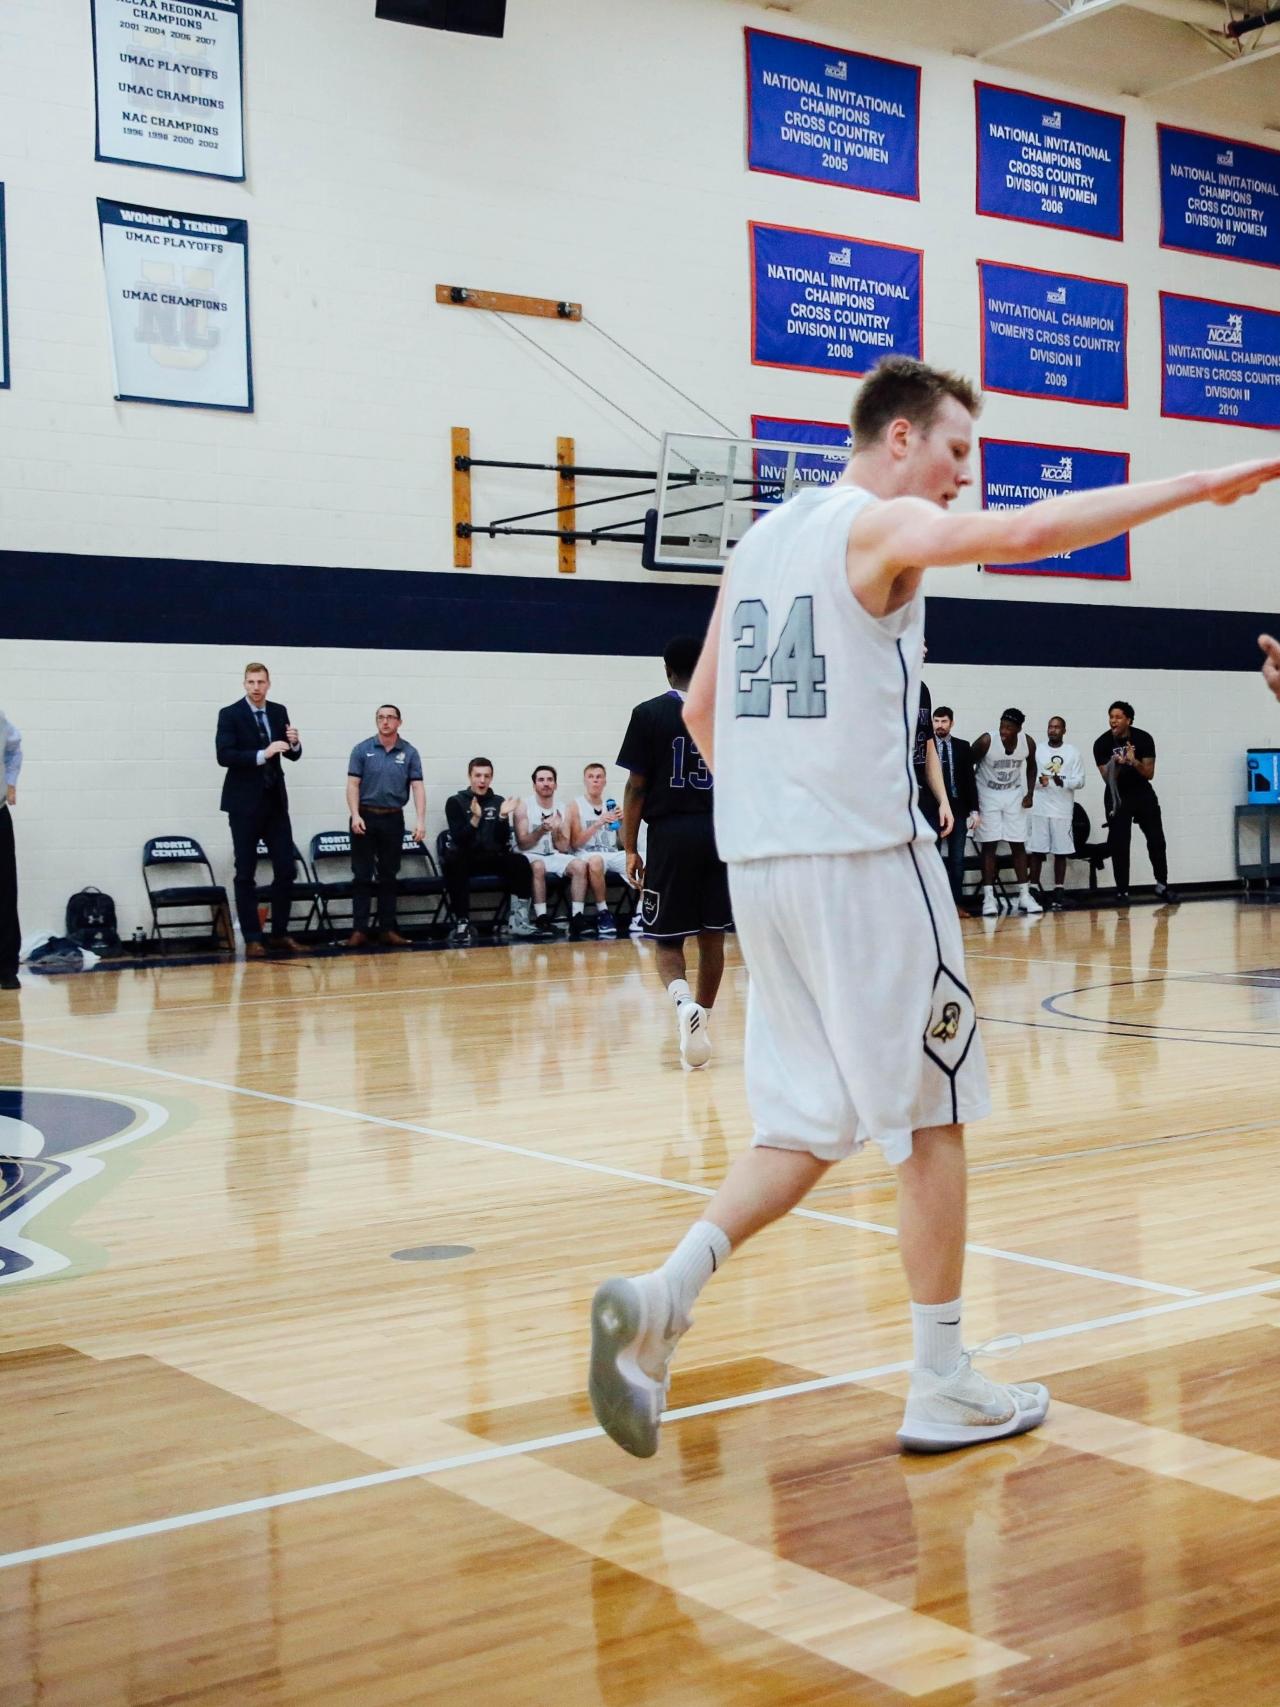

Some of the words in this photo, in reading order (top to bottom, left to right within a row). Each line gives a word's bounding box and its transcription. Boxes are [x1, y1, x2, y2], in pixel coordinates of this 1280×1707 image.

[133, 8, 203, 30] CHAMPIONS
[161, 2, 219, 21] REGIONAL
[144, 26, 166, 36] 2004
[119, 53, 154, 68] UMAC
[158, 60, 219, 80] PLAYOFFS
[118, 82, 154, 97] UMAC
[156, 89, 225, 110] CHAMPIONS
[763, 70, 823, 98] NATIONAL
[826, 86, 906, 118] INVITATIONAL
[800, 96, 870, 126] CHAMPIONS
[122, 111, 148, 125] NAC
[150, 116, 219, 136] CHAMPIONS
[784, 110, 825, 132] CROSS
[828, 121, 885, 146] COUNTRY
[781, 127, 831, 150] DIVISION
[834, 139, 841, 153] II
[844, 141, 889, 164] WOMEN
[989, 123, 1042, 147] NATIONAL
[1044, 135, 1111, 162] INVITATIONAL
[822, 153, 848, 172] 2005
[1021, 146, 1082, 170] CHAMPIONS
[1008, 160, 1044, 179] CROSS
[1046, 167, 1095, 189] COUNTRY
[1170, 163, 1217, 184] NATIONAL
[1218, 174, 1280, 196] INVITATIONAL
[1006, 175, 1049, 196] DIVISION
[1051, 186, 1057, 197] II
[1058, 187, 1098, 206] WOMEN
[1199, 185, 1252, 205] CHAMPIONS
[1041, 199, 1063, 214] 2006
[1187, 197, 1219, 214] CROSS
[1220, 203, 1264, 222] COUNTRY
[182, 219, 229, 236] TENNIS
[1185, 212, 1224, 230] DIVISION
[1225, 219, 1231, 231] II
[1232, 220, 1267, 238] WOMEN
[125, 231, 160, 245] UMAC
[163, 237, 223, 254] PLAYOFFS
[1216, 232, 1237, 247] 2007
[767, 263, 829, 288] NATIONAL
[830, 274, 910, 301] INVITATIONAL
[122, 289, 158, 303] UMAC
[161, 294, 228, 312] CHAMPIONS
[805, 287, 875, 311] CHAMPIONS
[790, 302, 831, 322] CROSS
[833, 310, 890, 330] COUNTRY
[988, 298, 1059, 325] INVITATIONAL
[1061, 312, 1114, 332] CHAMPION
[787, 319, 837, 339] DIVISION
[839, 327, 847, 341] II
[848, 328, 894, 348] WOMEN
[990, 320, 1034, 341] WOMEN'S
[1036, 329, 1071, 347] CROSS
[1072, 335, 1121, 353] COUNTRY
[1207, 328, 1242, 344] NCCAA
[827, 343, 854, 359] 2008
[1030, 347, 1073, 366] DIVISION
[1075, 354, 1082, 367] II
[1168, 344, 1230, 362] INVITATIONAL
[1044, 371, 1068, 387] 2009
[1166, 363, 1210, 380] WOMEN'S
[1212, 368, 1242, 382] CROSS
[1205, 385, 1242, 400] DIVISION
[1244, 389, 1250, 401] II
[1218, 403, 1239, 416] 2010
[760, 464, 843, 484] INVIATIONA
[1040, 468, 1072, 481] NCCAA
[732, 595, 827, 719] 24
[669, 736, 714, 790] 13
[151, 848, 200, 857] CENTRAL
[155, 841, 192, 849] NORTH
